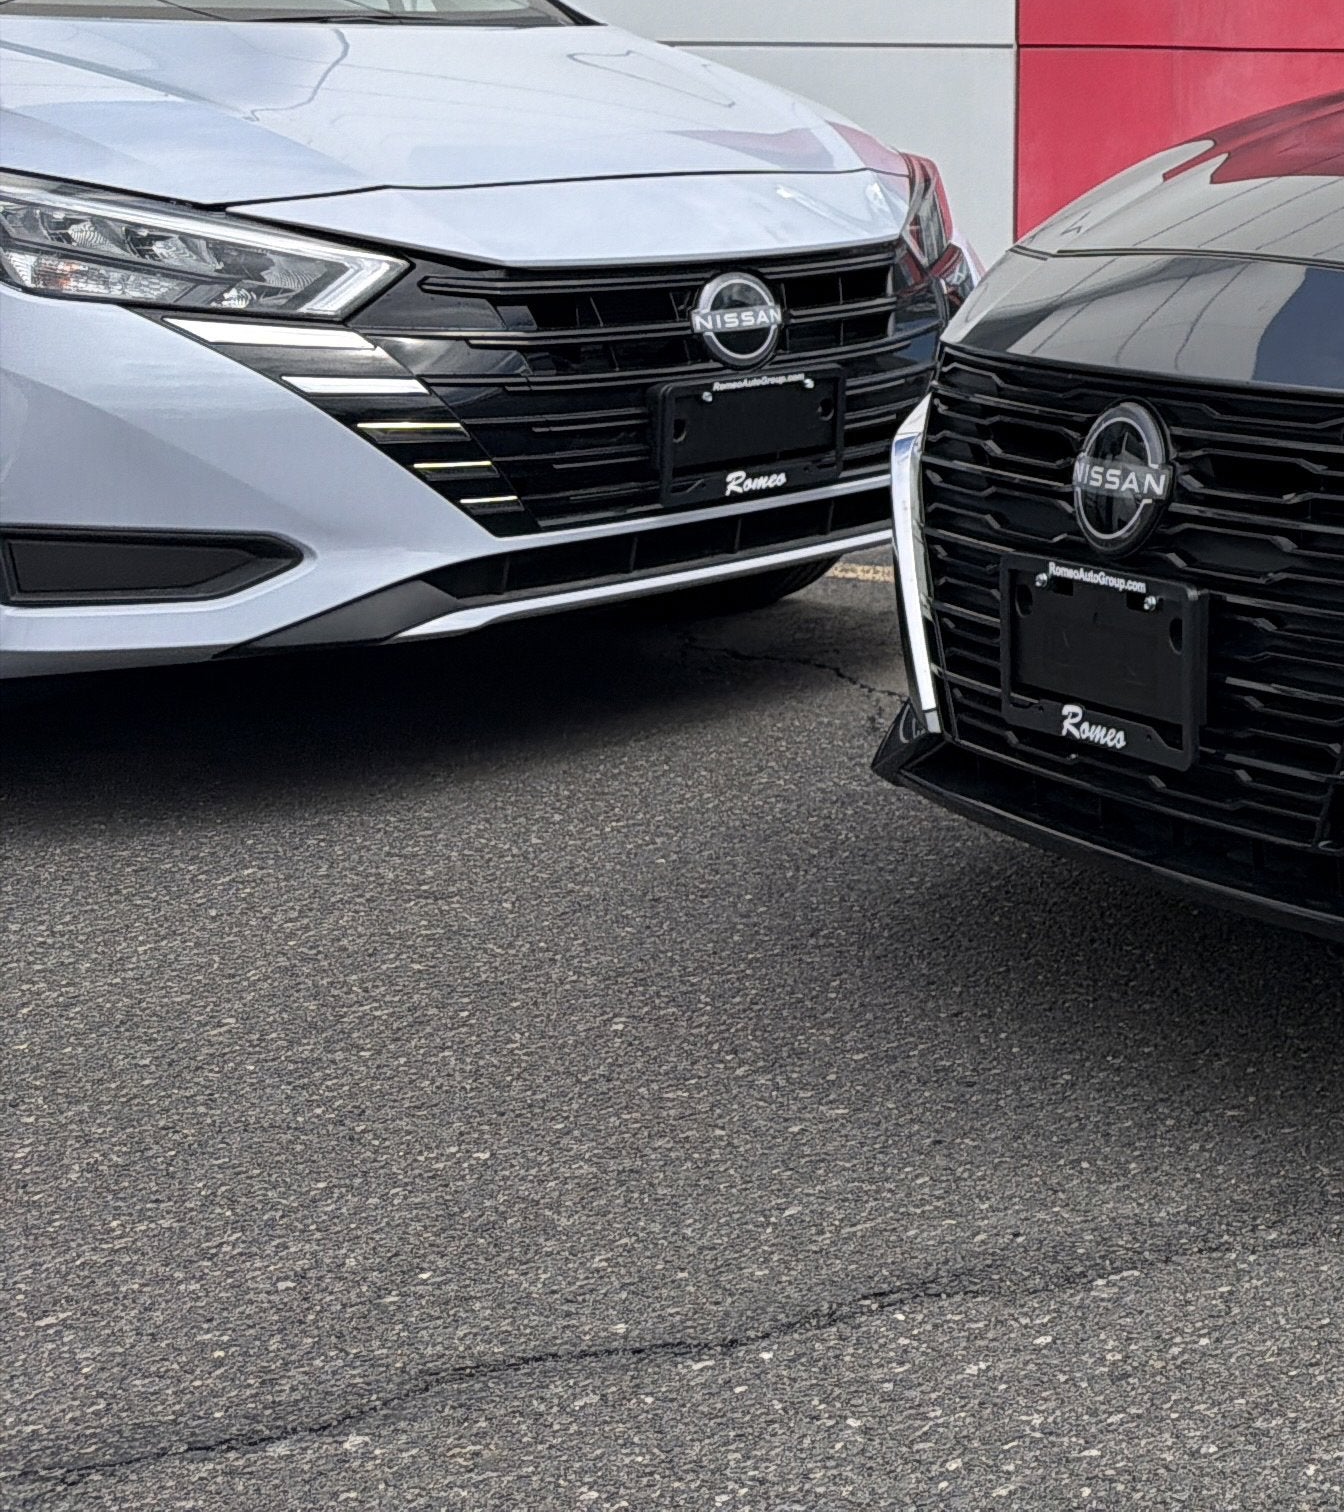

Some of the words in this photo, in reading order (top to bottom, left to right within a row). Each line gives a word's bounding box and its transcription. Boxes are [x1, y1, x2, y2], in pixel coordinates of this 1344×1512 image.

[694, 308, 782, 330] NISSAN
[712, 372, 805, 392] RomeoAutoGroup.com
[725, 470, 787, 497] Romeo
[1073, 460, 1166, 496] NISSAN
[1048, 561, 1147, 594] RomeoAutoGroup.com
[1061, 704, 1127, 750] Romeo
